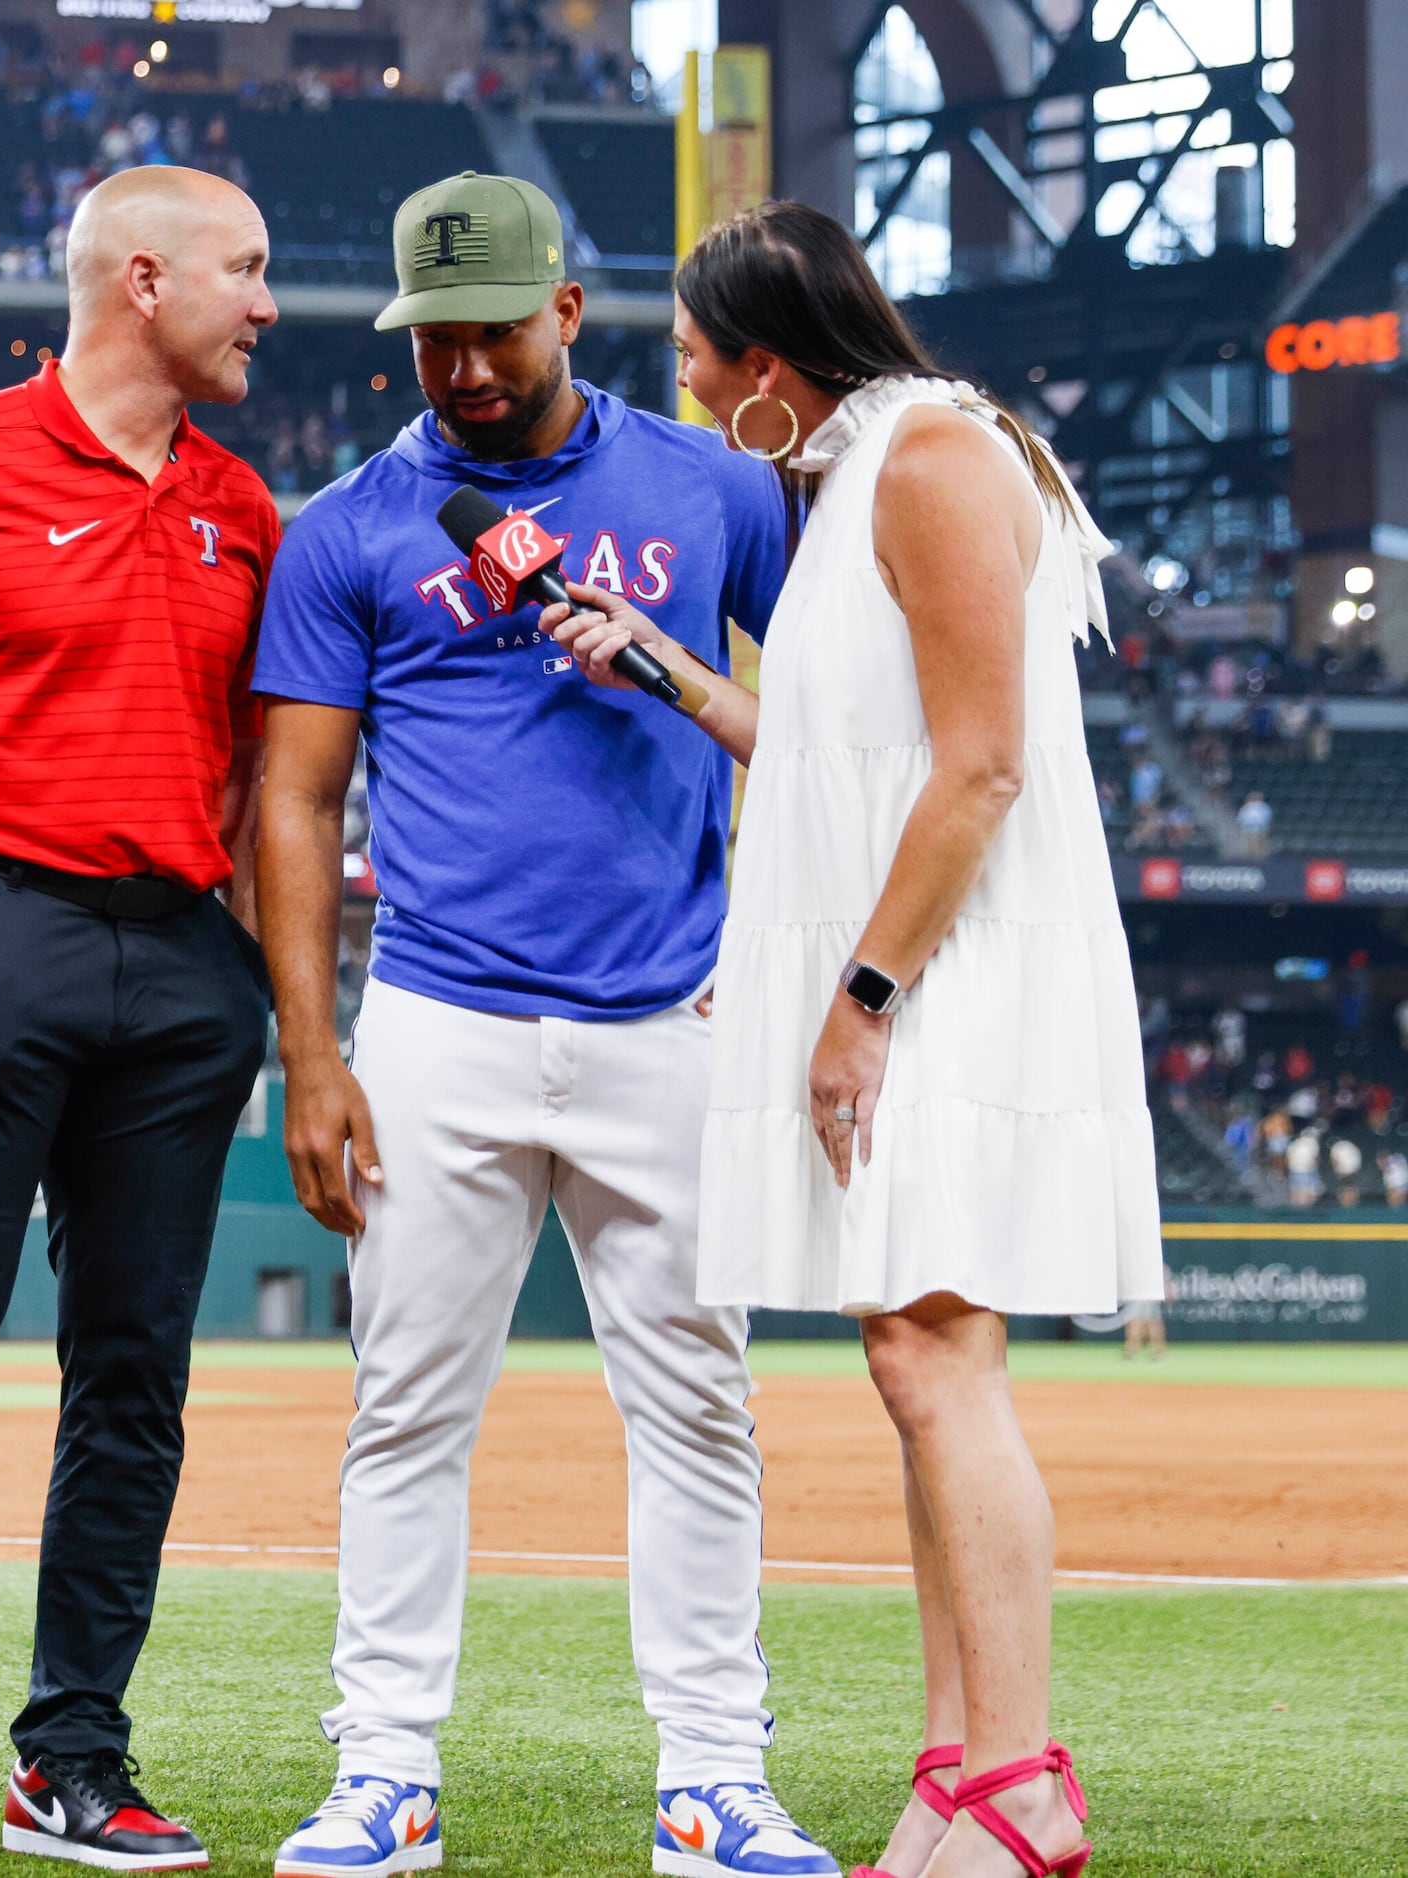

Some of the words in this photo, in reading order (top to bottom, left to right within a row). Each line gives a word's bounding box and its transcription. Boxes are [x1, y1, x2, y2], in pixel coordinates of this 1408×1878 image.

[425, 212, 471, 266] T
[190, 515, 221, 566] T
[413, 530, 677, 634] TAS
[1181, 865, 1266, 892] TOYOTA
